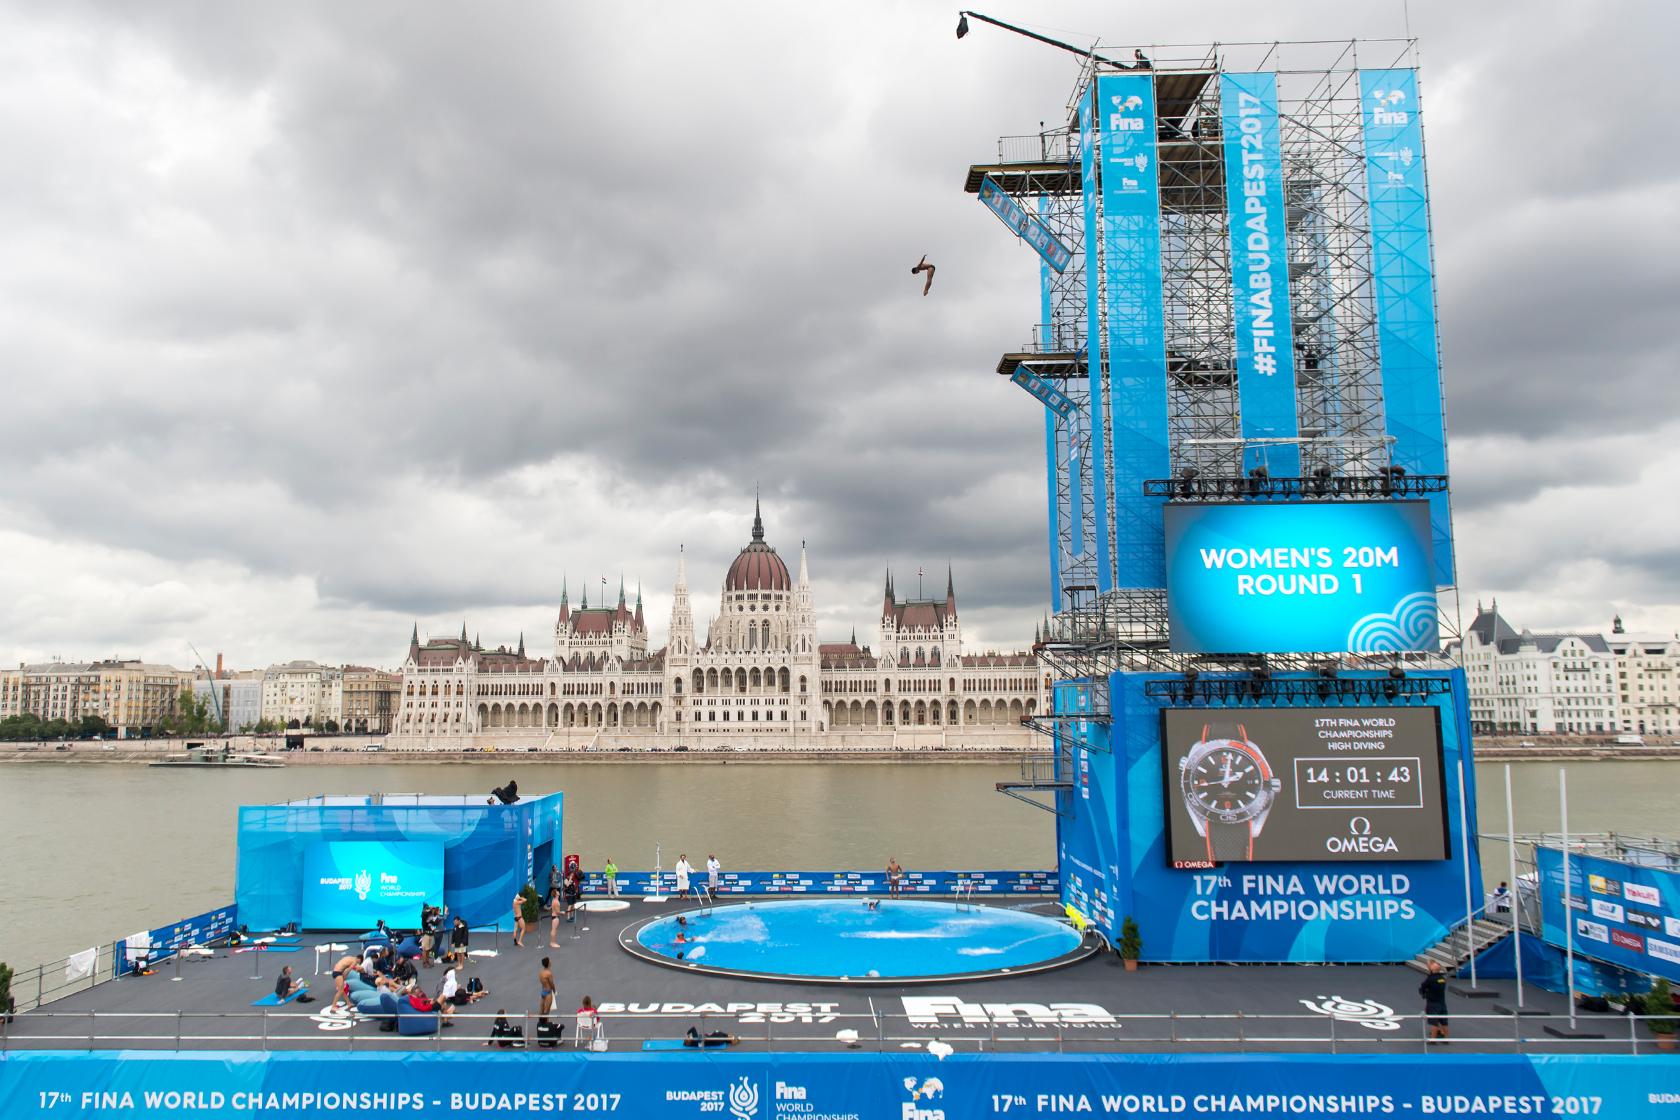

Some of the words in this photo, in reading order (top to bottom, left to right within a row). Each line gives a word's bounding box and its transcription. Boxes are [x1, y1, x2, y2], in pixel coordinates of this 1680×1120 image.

[1110, 113, 1144, 131] Fina
[1374, 107, 1408, 125] Fina
[1238, 92, 1278, 376] #FINABUDAPEST2017
[1200, 548, 1332, 568] WOMEN'S
[1343, 547, 1398, 567] 20M
[1238, 574, 1339, 595] ROUND
[1352, 574, 1362, 594] 1
[1315, 719, 1338, 728] 17TH
[1339, 719, 1360, 727] FINA
[1361, 719, 1396, 727] WORLD
[1318, 730, 1393, 738] CHAMPIONSHIPS
[1328, 742, 1352, 750] HIGH
[1353, 742, 1385, 750] DIVING
[1323, 789, 1369, 799] CURRENT
[1372, 789, 1396, 799] TIME
[1327, 837, 1399, 853] OMEGA
[1193, 875, 1232, 895] 17th
[1243, 875, 1305, 895] FINA
[1314, 875, 1410, 895] WORLD
[1191, 899, 1416, 921] CHAMPIONSHIPS
[597, 1002, 840, 1013] BUDAPEST
[901, 996, 1118, 1023] Fina
[738, 1012, 841, 1023] 2017
[666, 1091, 725, 1101] BUDAPEST
[776, 1082, 806, 1099] Fina
[39, 1092, 72, 1109] 17th
[82, 1092, 135, 1109] FINA
[144, 1092, 225, 1110] WORLD
[232, 1092, 424, 1110] CHAMPIONSHIPS
[450, 1094, 567, 1111] BUDAPEST
[573, 1094, 621, 1111] 2017
[700, 1101, 724, 1111] 2017
[776, 1103, 814, 1113] WORLD
[992, 1094, 1027, 1112] 17th
[1037, 1095, 1093, 1112] FINA
[1102, 1095, 1187, 1113] WORLD
[1193, 1095, 1395, 1114] CHAMPIONSHIPS
[1421, 1096, 1545, 1114] BUDAPEST
[1551, 1097, 1602, 1114] 2017
